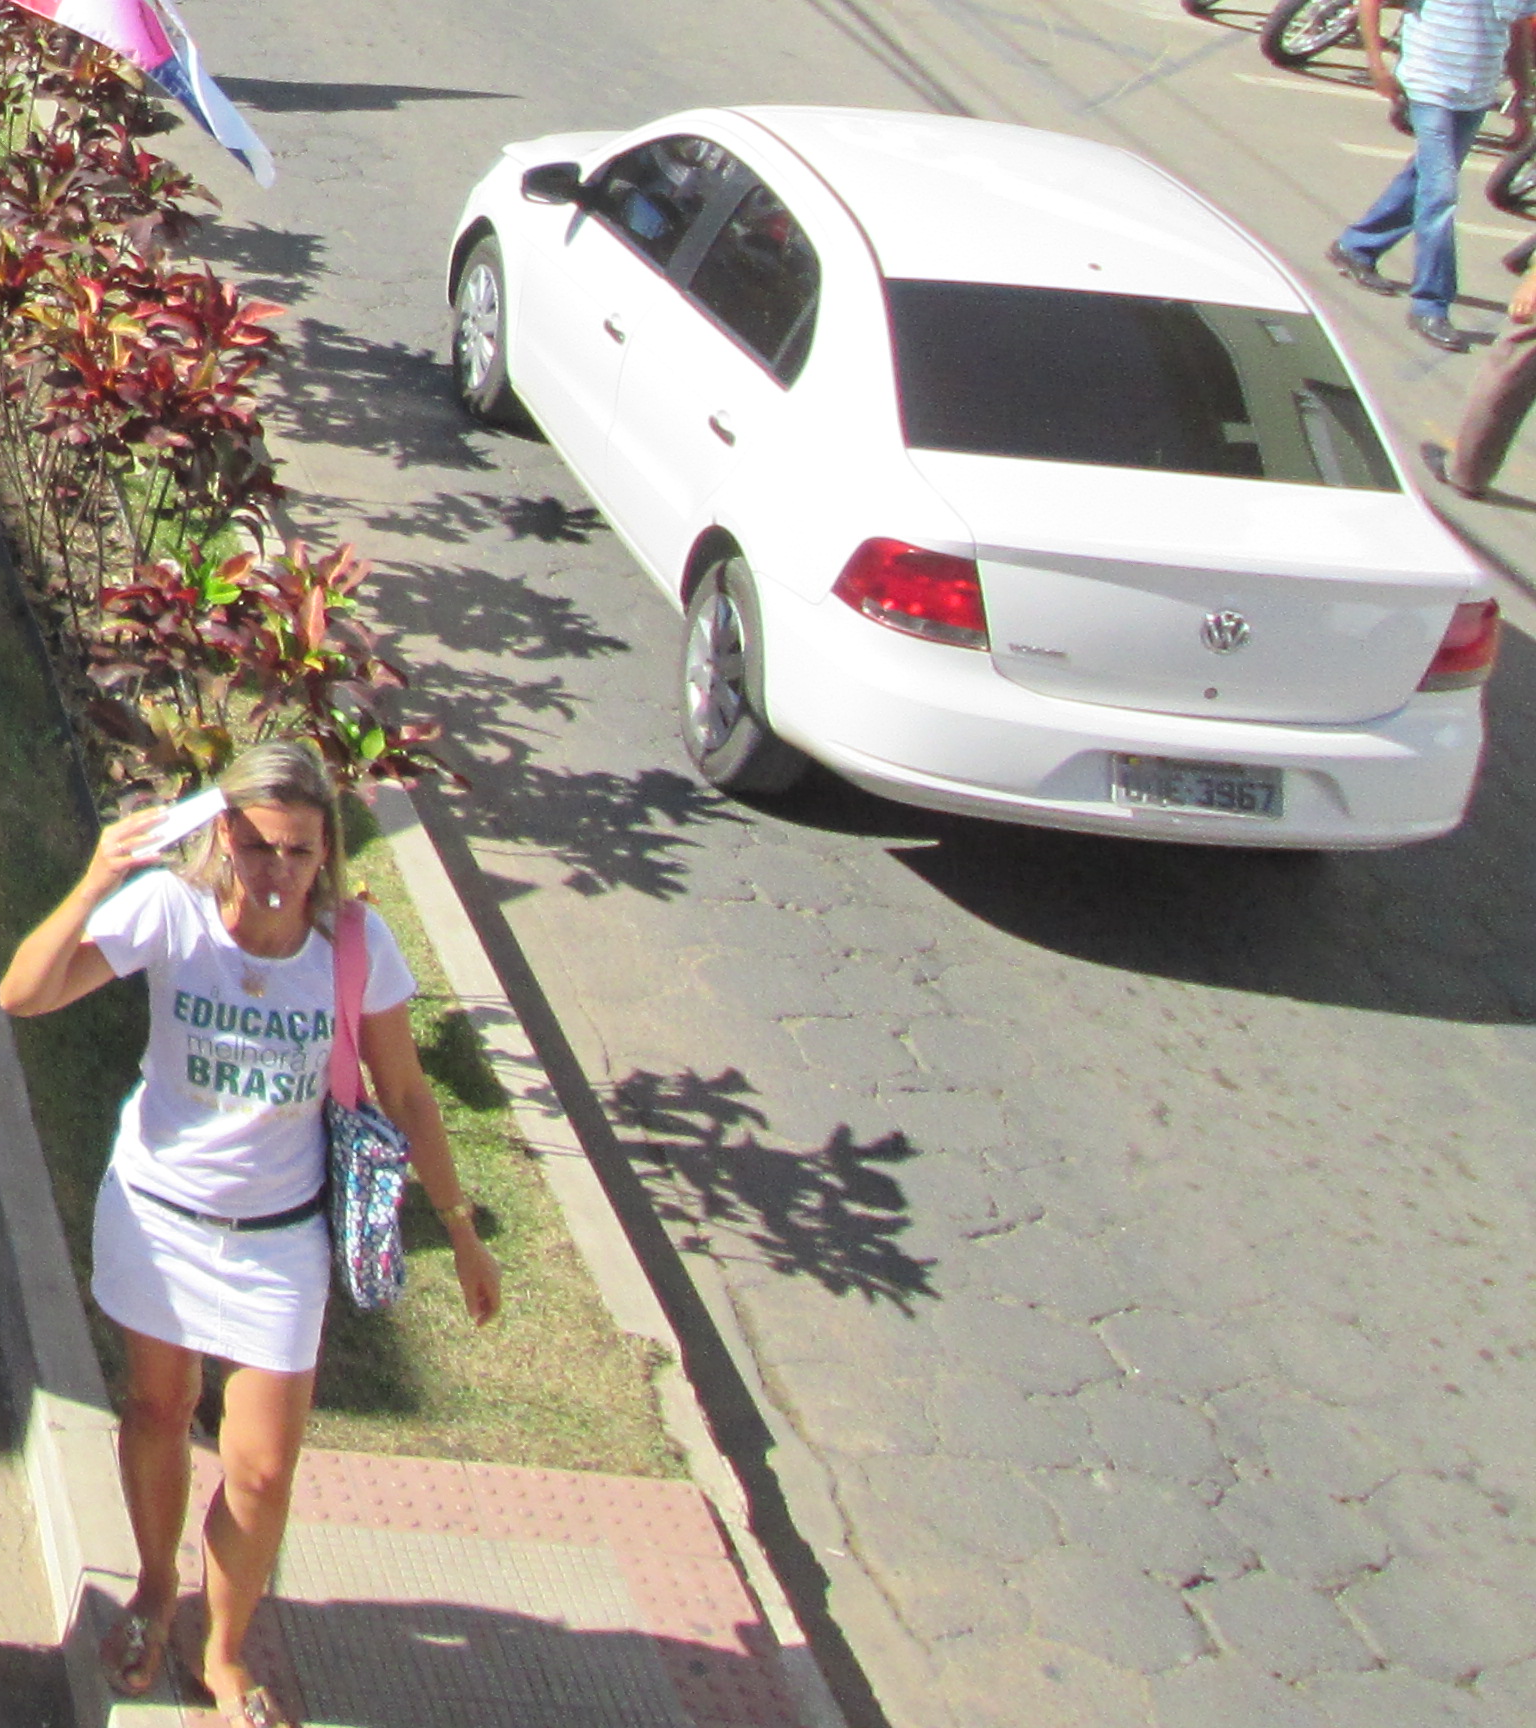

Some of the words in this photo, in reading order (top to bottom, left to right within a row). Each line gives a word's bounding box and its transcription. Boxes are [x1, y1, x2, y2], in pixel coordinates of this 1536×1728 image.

[173, 990, 335, 1051] EDUCAÇÃ
[186, 1031, 311, 1073] melhora
[186, 1053, 320, 1106] BRASIL
